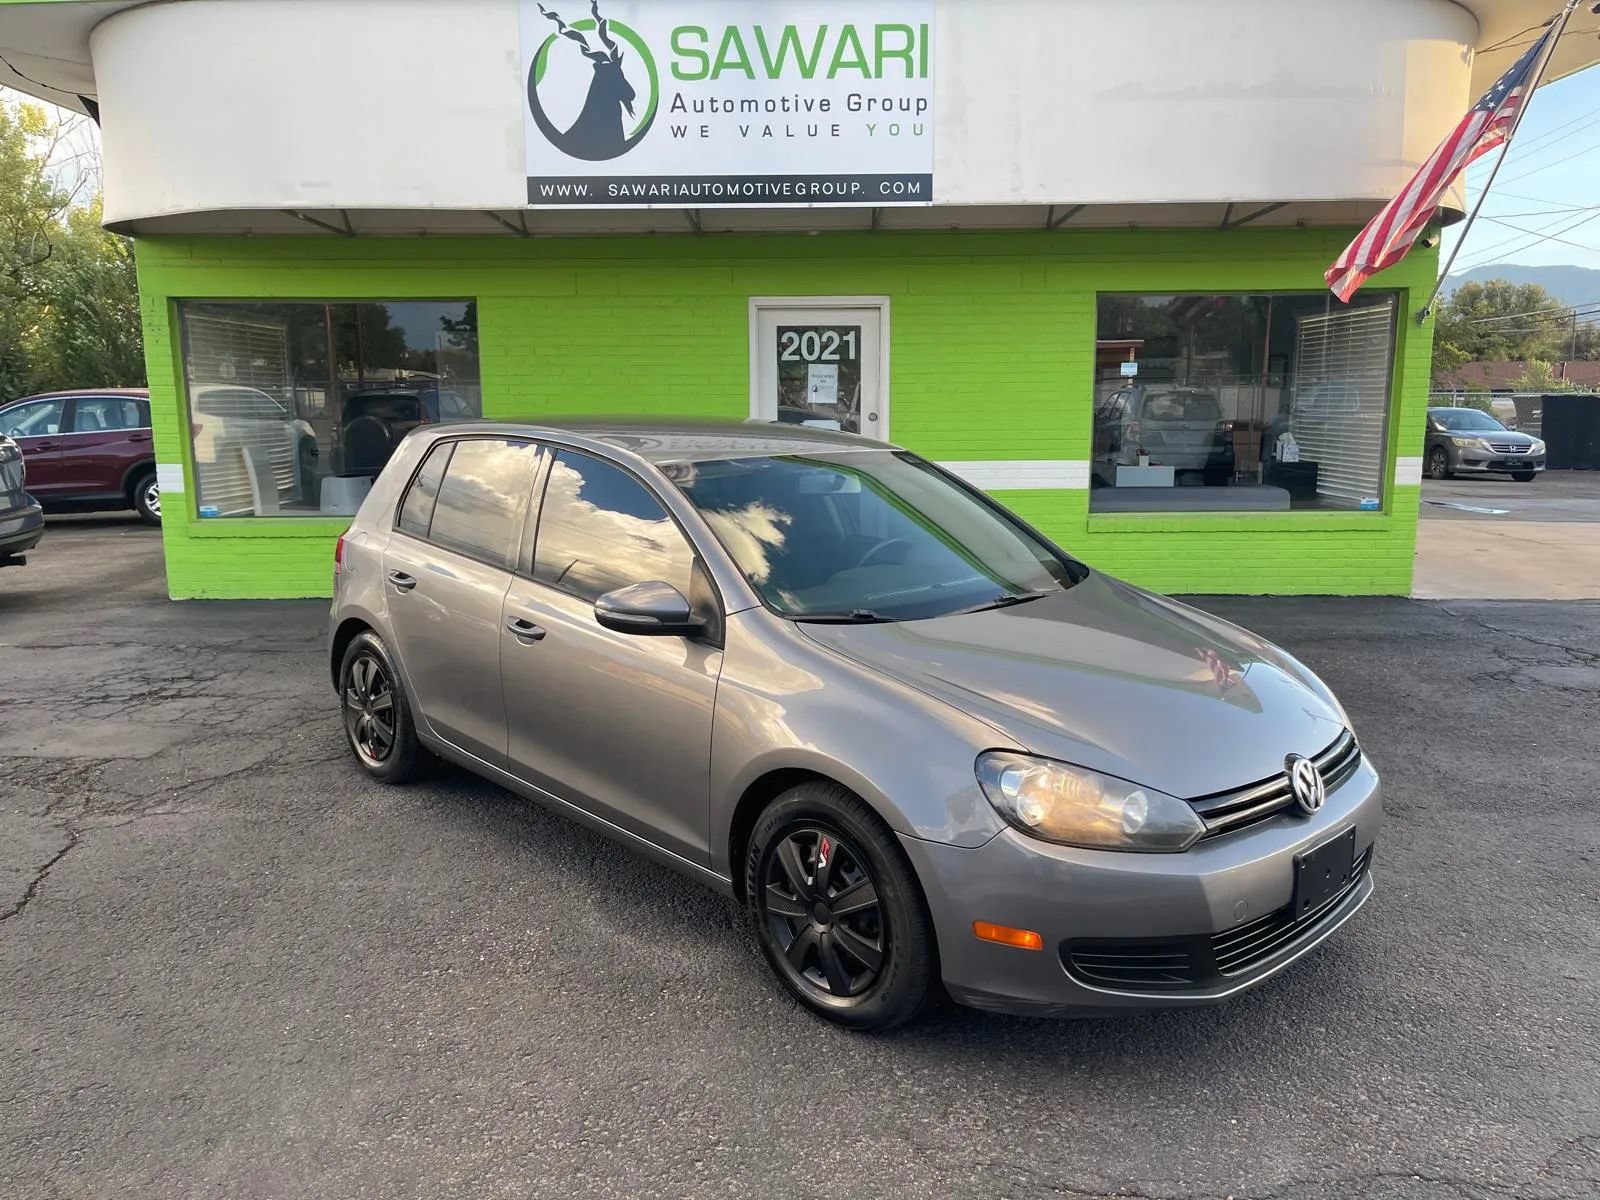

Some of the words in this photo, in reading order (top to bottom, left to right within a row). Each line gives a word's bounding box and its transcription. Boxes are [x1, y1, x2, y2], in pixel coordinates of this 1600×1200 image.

[670, 23, 929, 81] SAWARI
[670, 92, 831, 114] Automotive
[847, 93, 928, 116] Group
[671, 125, 709, 138] WE
[739, 124, 840, 138] VALUE
[866, 123, 924, 137] YOU
[879, 181, 921, 194] COM
[780, 330, 856, 361] 2021
